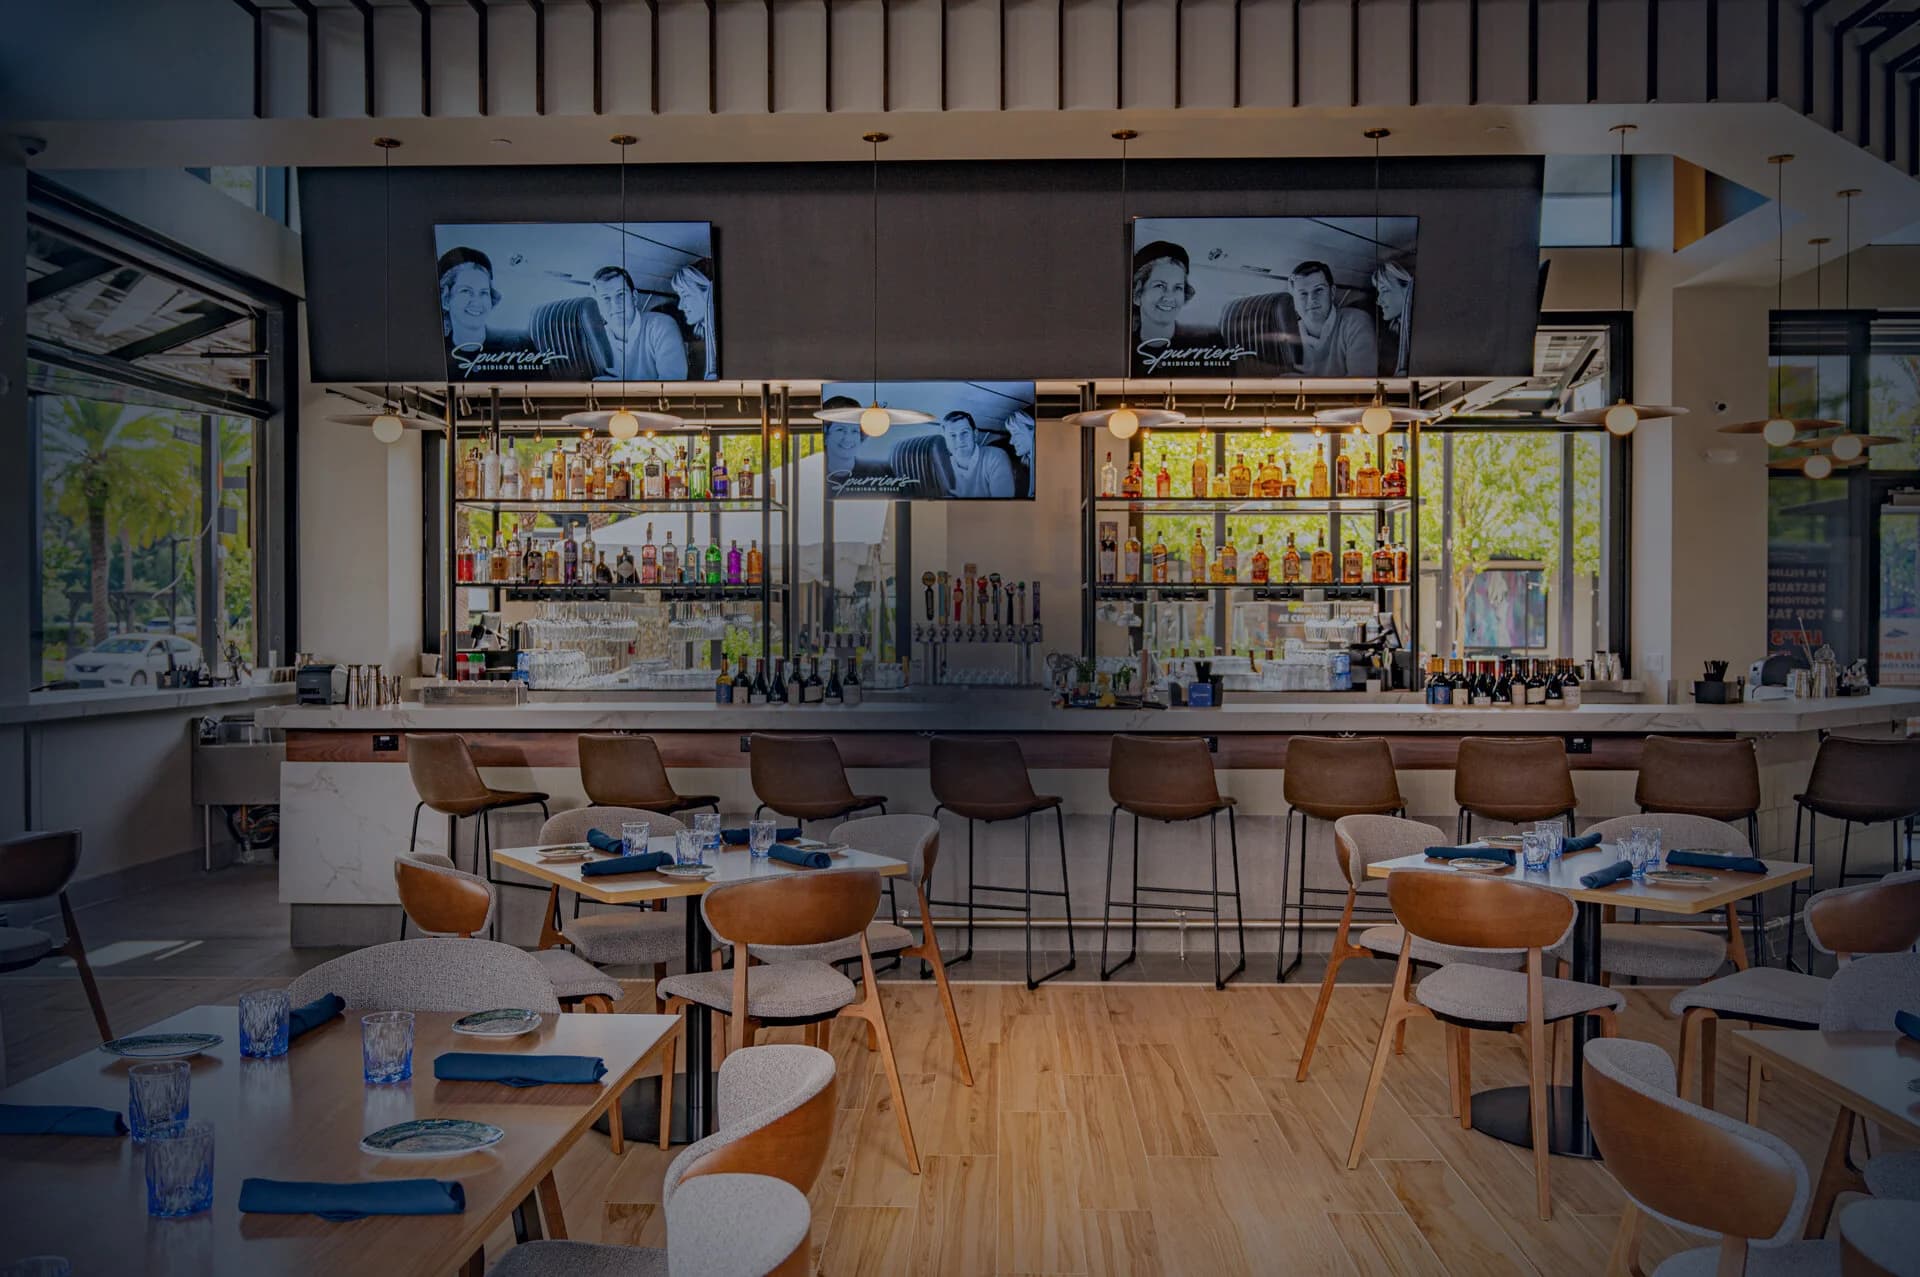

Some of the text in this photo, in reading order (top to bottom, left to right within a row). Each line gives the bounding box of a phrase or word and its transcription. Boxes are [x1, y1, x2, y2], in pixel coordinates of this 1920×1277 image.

[451, 342, 569, 379] Spurrier's
[1136, 337, 1258, 375] Spurrier's
[826, 469, 921, 497] Spurrier's
